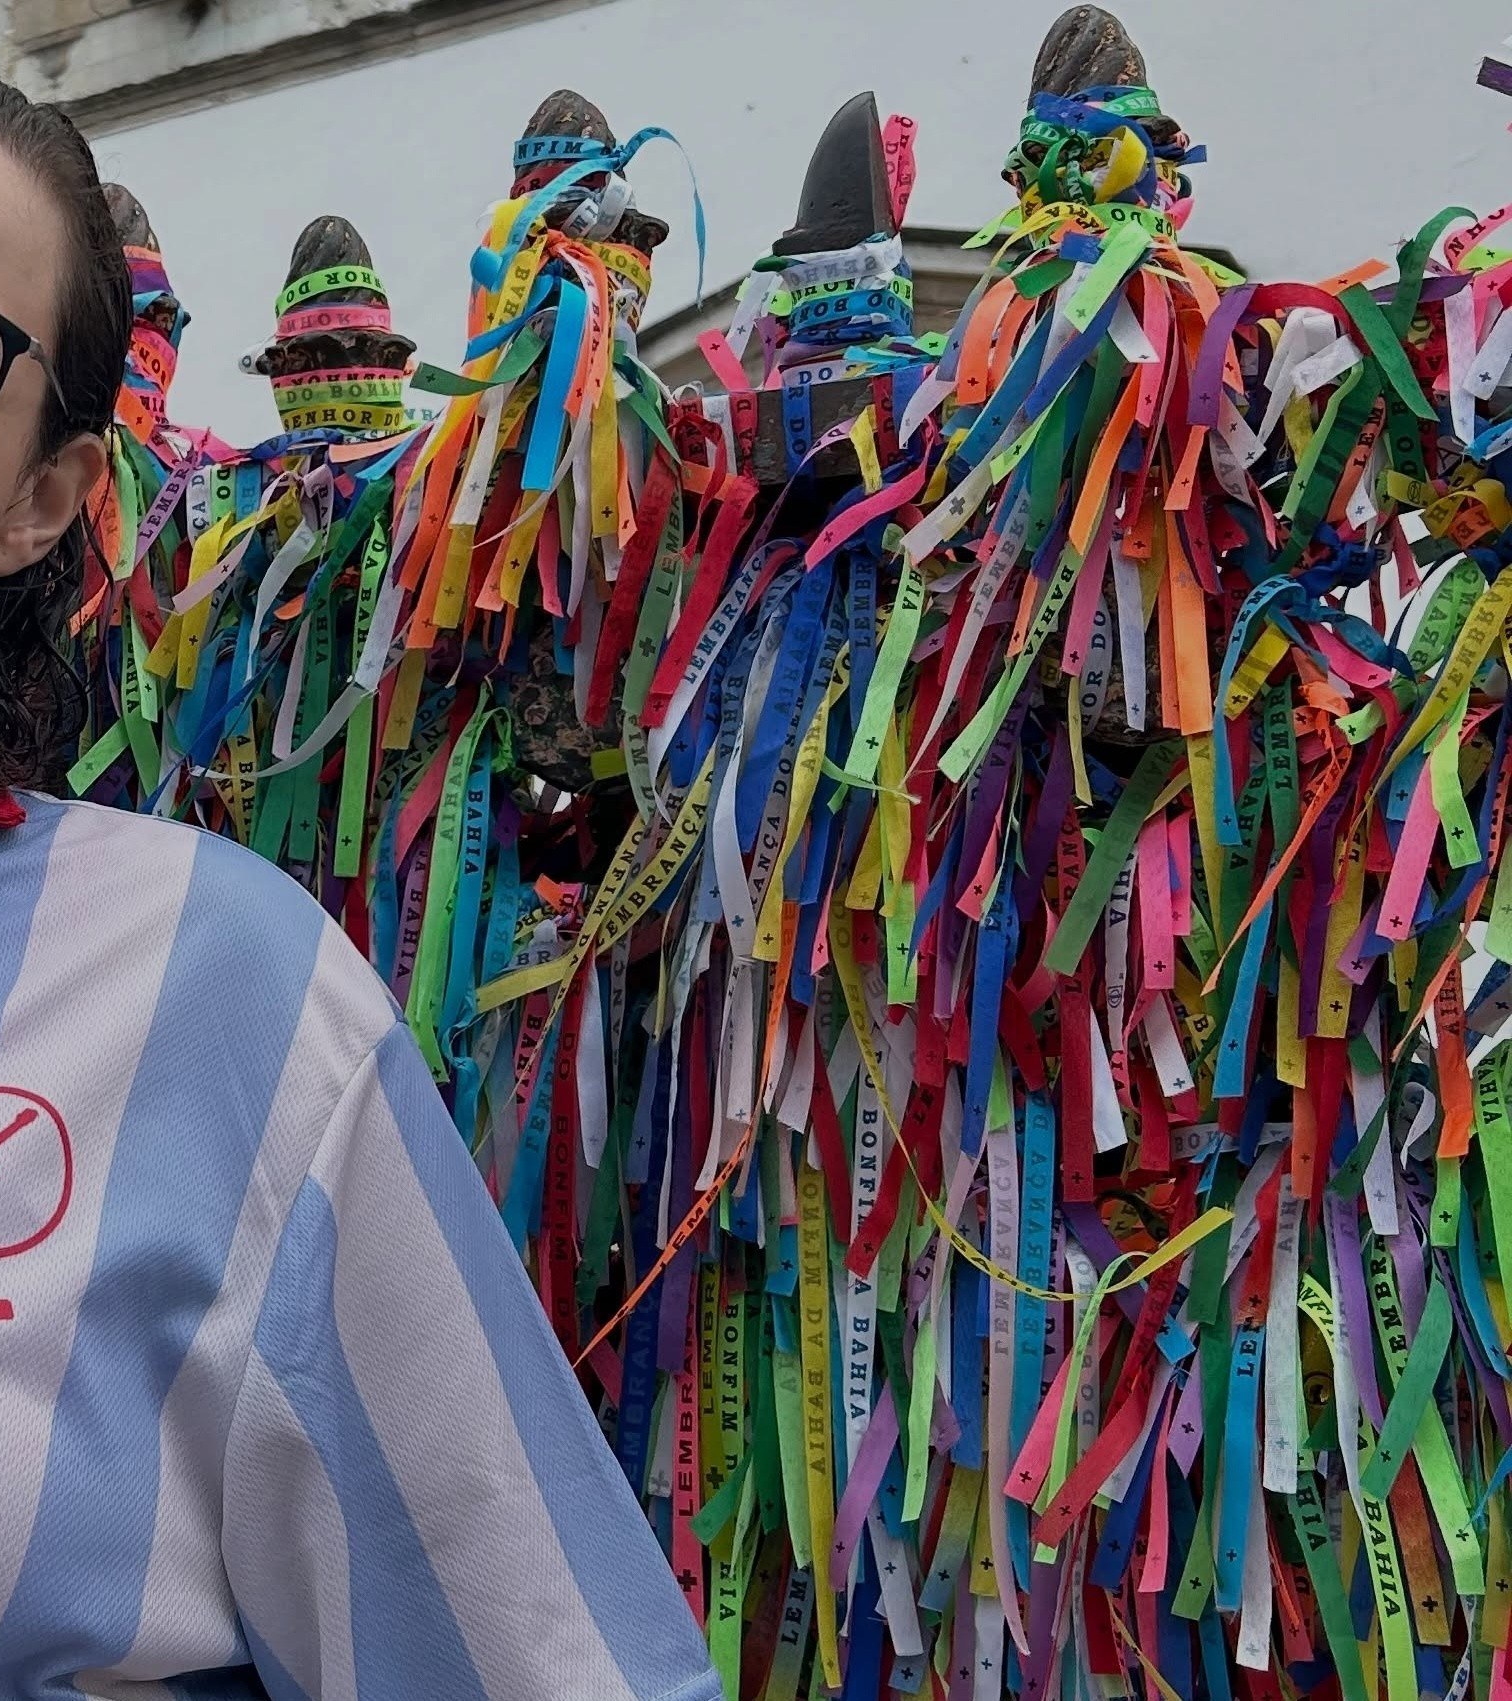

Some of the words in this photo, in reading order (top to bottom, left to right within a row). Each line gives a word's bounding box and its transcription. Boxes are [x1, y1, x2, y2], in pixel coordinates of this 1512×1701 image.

[285, 280, 311, 304] DO
[798, 366, 834, 385] DO
[284, 408, 373, 430] SENHOR
[383, 411, 401, 428] DO
[788, 418, 807, 456] DO
[216, 467, 232, 500] DO
[364, 538, 388, 569] DA
[901, 564, 925, 612] HIA
[1023, 563, 1076, 660] BAHIA
[684, 546, 774, 685] LEMBRANÇA
[1090, 608, 1108, 651] DO
[1270, 686, 1294, 790] LEMBR
[773, 757, 795, 798] DO
[463, 789, 484, 876] BAHIA
[592, 830, 645, 917] ONFIM
[396, 888, 423, 980] BAHIA
[558, 1032, 575, 1080] DO
[720, 1303, 740, 1434] BONFIM
[849, 1315, 873, 1420] BAHIA
[1363, 1496, 1402, 1620] BAHIA
